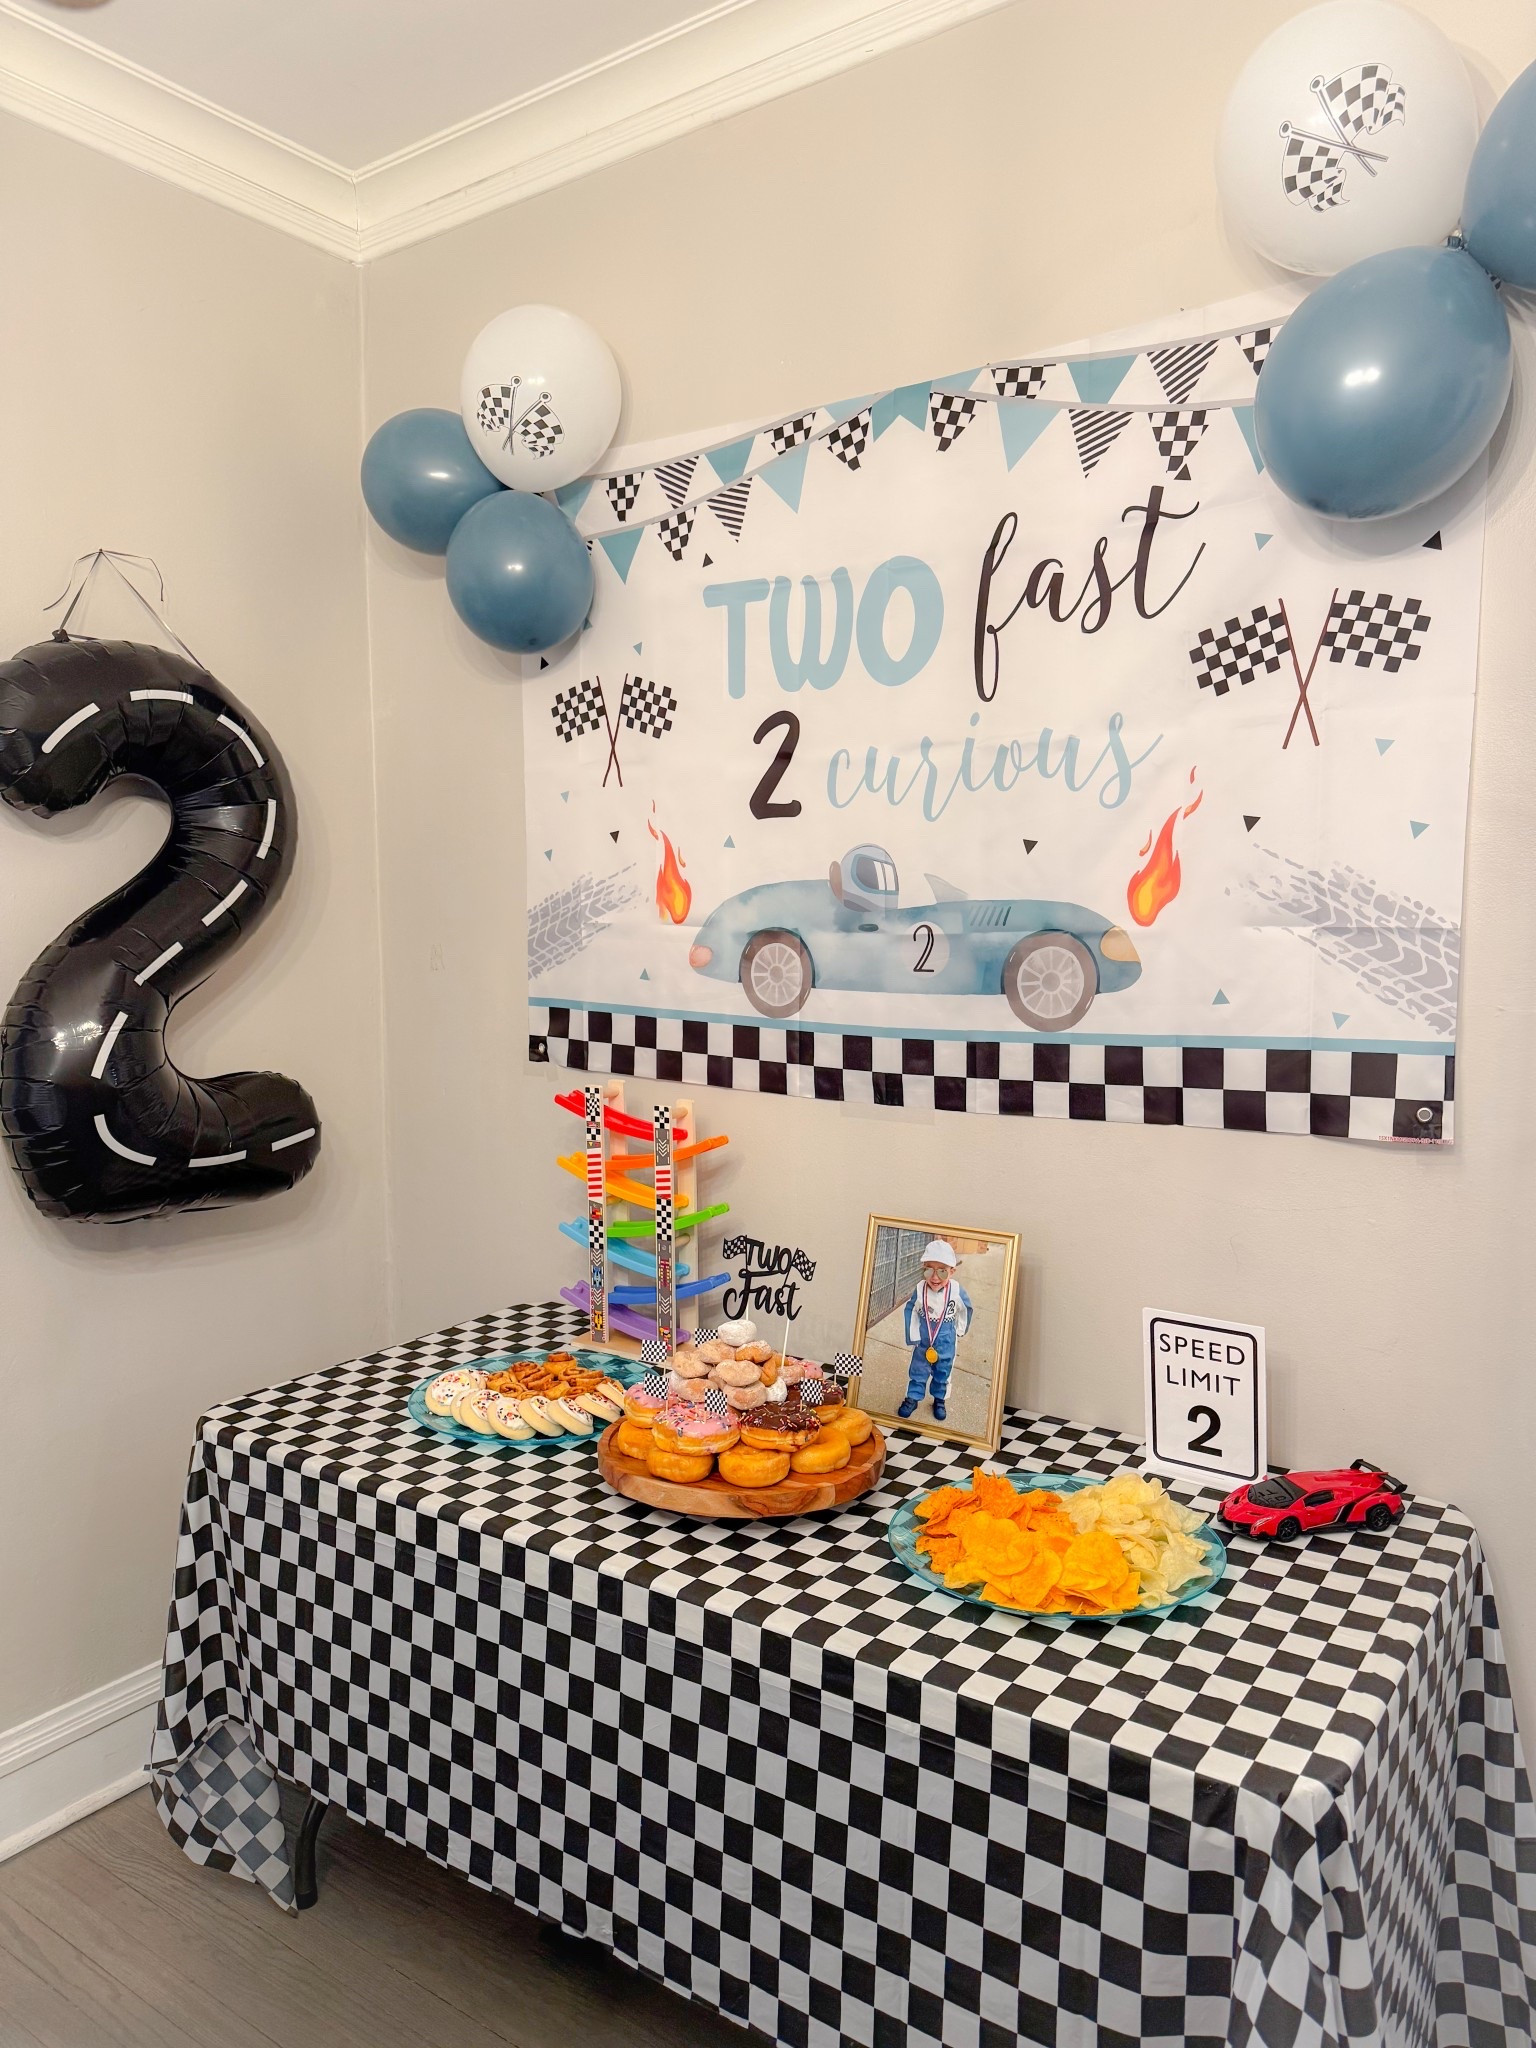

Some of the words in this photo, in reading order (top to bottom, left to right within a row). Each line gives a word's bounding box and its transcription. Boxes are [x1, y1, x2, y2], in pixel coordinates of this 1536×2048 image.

[703, 555, 944, 699] TWO
[974, 485, 1206, 702] fast
[749, 710, 802, 820] 2
[826, 711, 1164, 822] curious
[912, 924, 935, 973] 2
[745, 1238, 793, 1274] Two
[722, 1268, 803, 1321] Fast
[1159, 1333, 1246, 1366] SPEED
[1166, 1364, 1241, 1397] LIMIT
[1187, 1404, 1223, 1458] 2
